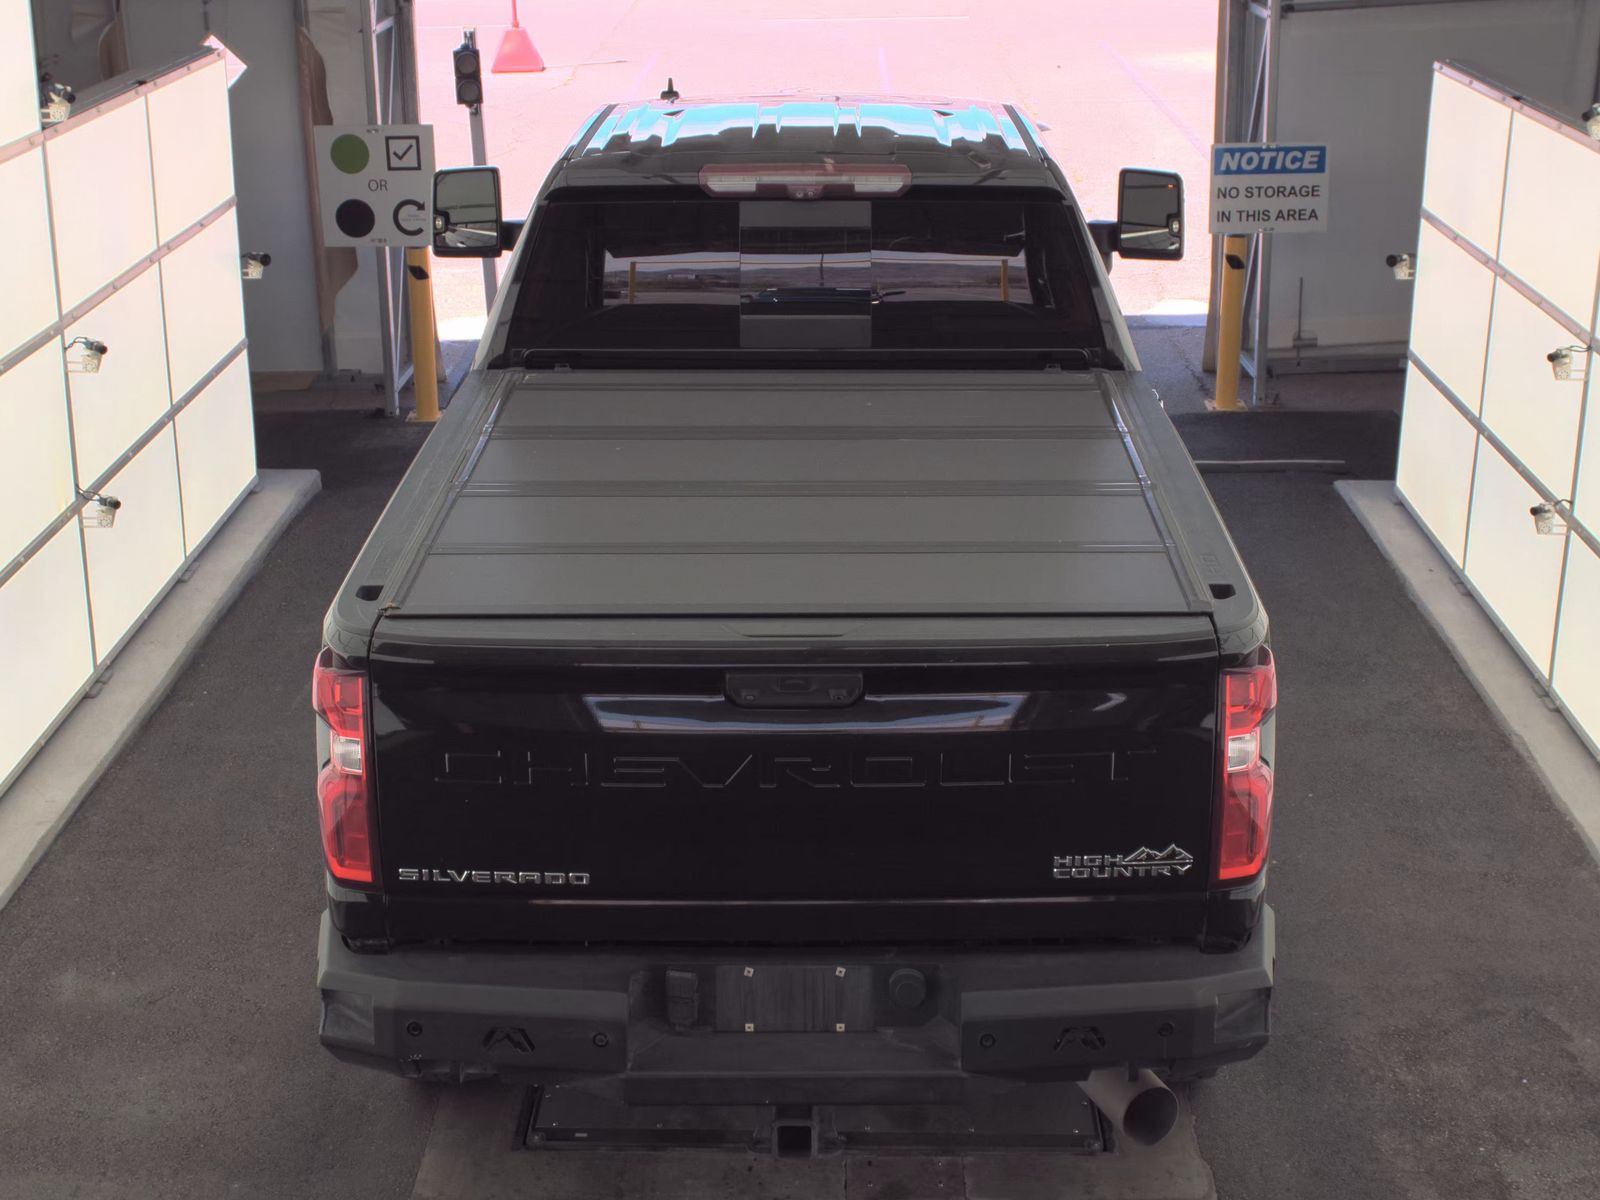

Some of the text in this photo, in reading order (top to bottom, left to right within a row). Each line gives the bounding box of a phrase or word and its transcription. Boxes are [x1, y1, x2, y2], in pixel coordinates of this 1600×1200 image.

[1220, 151, 1320, 171] NOTICE
[367, 179, 388, 192] OR
[1217, 185, 1321, 199] NO STORAGE
[1217, 208, 1319, 222] IN THIS AREA
[433, 749, 1157, 789] CHEVROLET
[1053, 854, 1123, 866] HIGH
[398, 868, 590, 885] SILVERADO
[1053, 864, 1192, 878] COUNTRY
